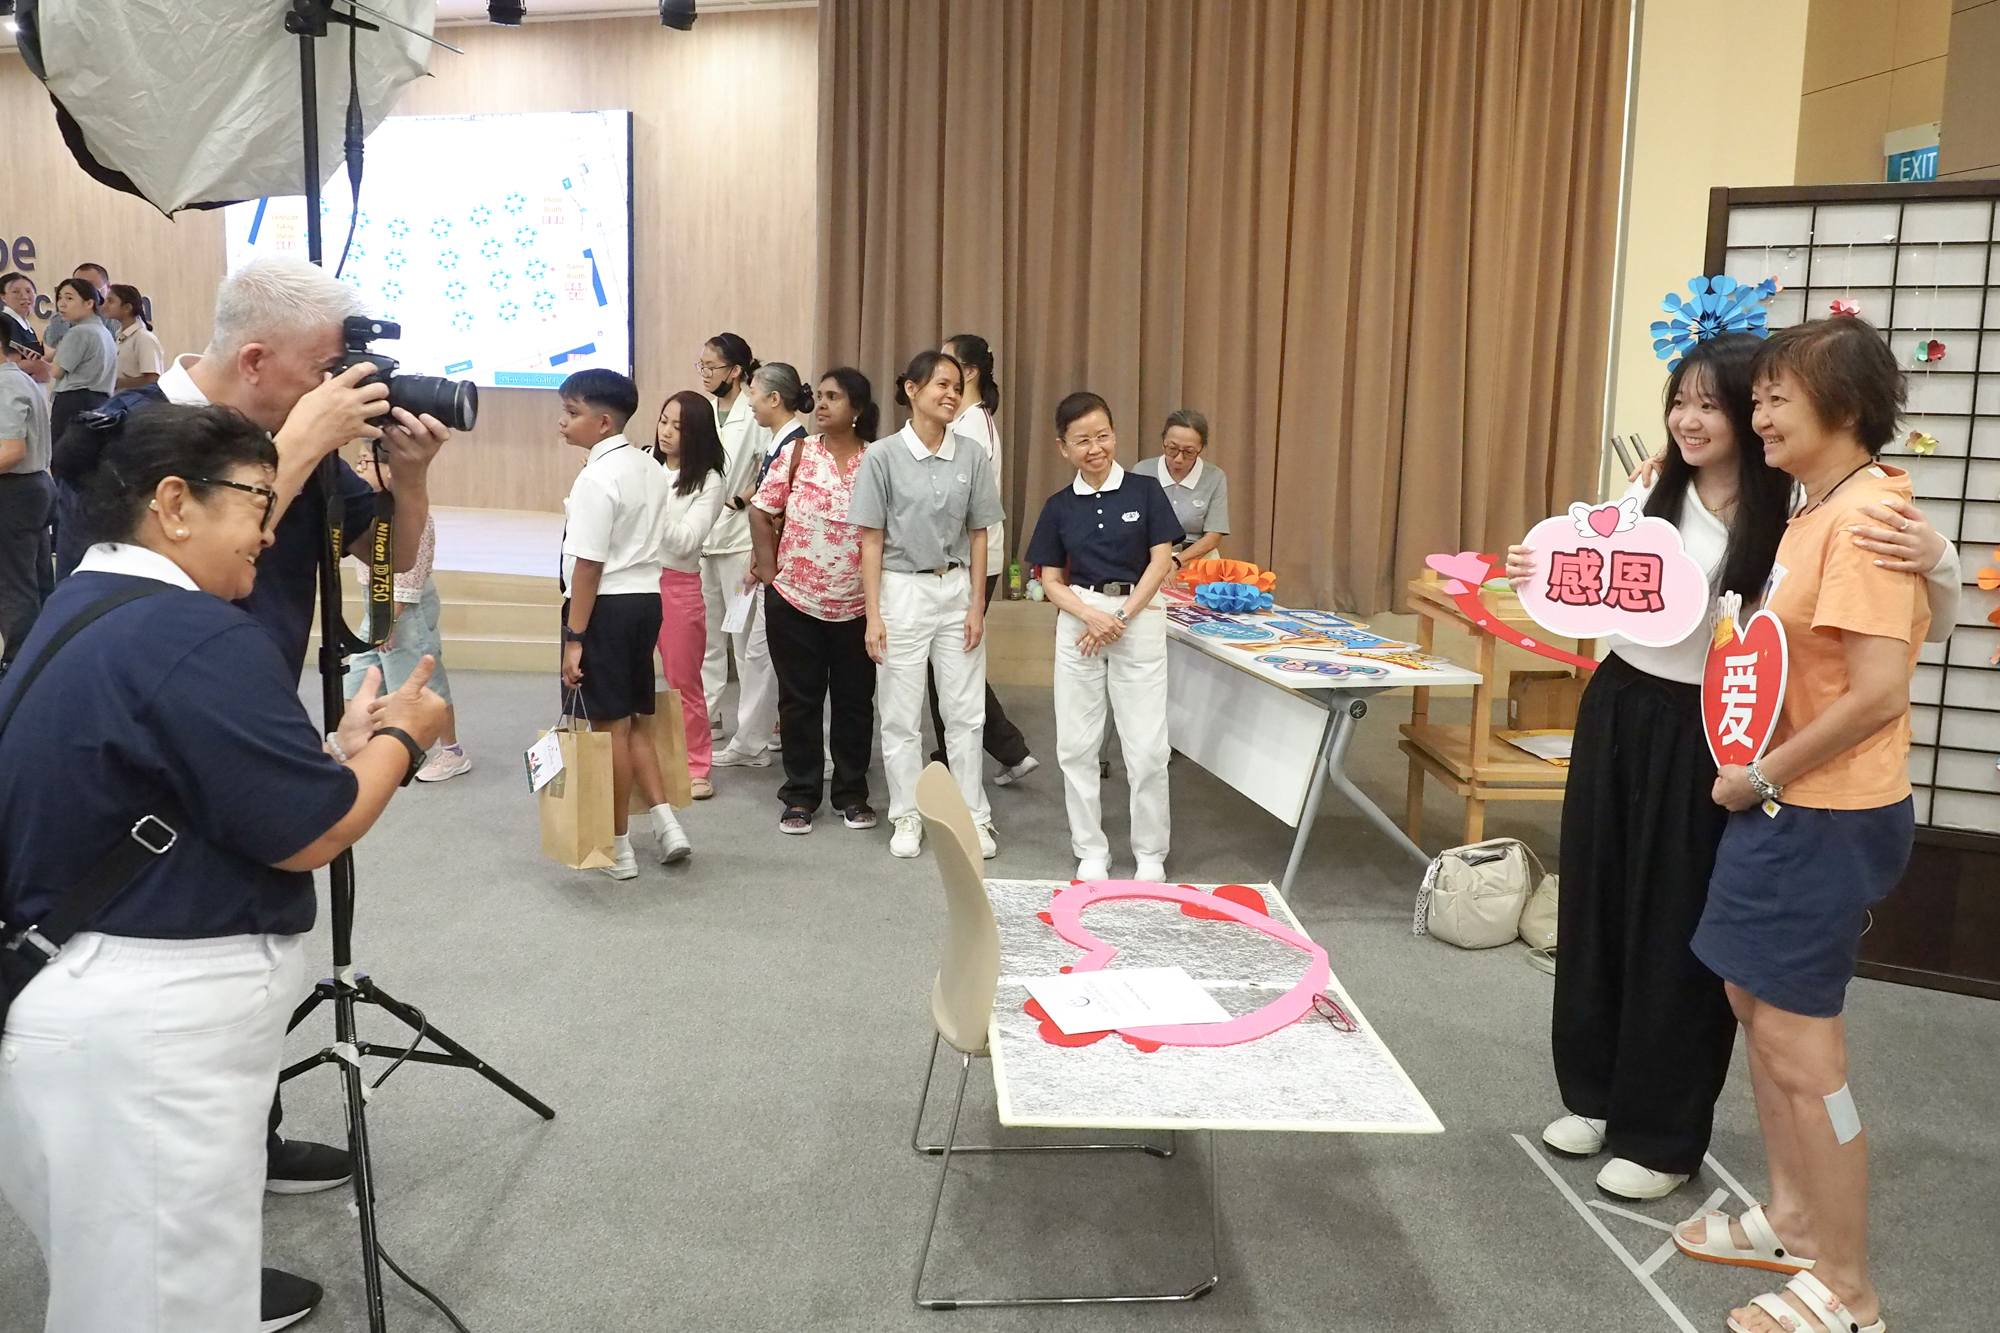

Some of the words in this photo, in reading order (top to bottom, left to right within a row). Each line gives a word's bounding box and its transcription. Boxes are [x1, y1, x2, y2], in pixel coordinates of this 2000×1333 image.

[1900, 152, 1938, 182] EXIT
[276, 223, 295, 231] Taking
[374, 522, 389, 562] Nikon
[372, 564, 390, 602] D750
[1545, 547, 1665, 613] 感恩
[1717, 650, 1758, 749] 爱
